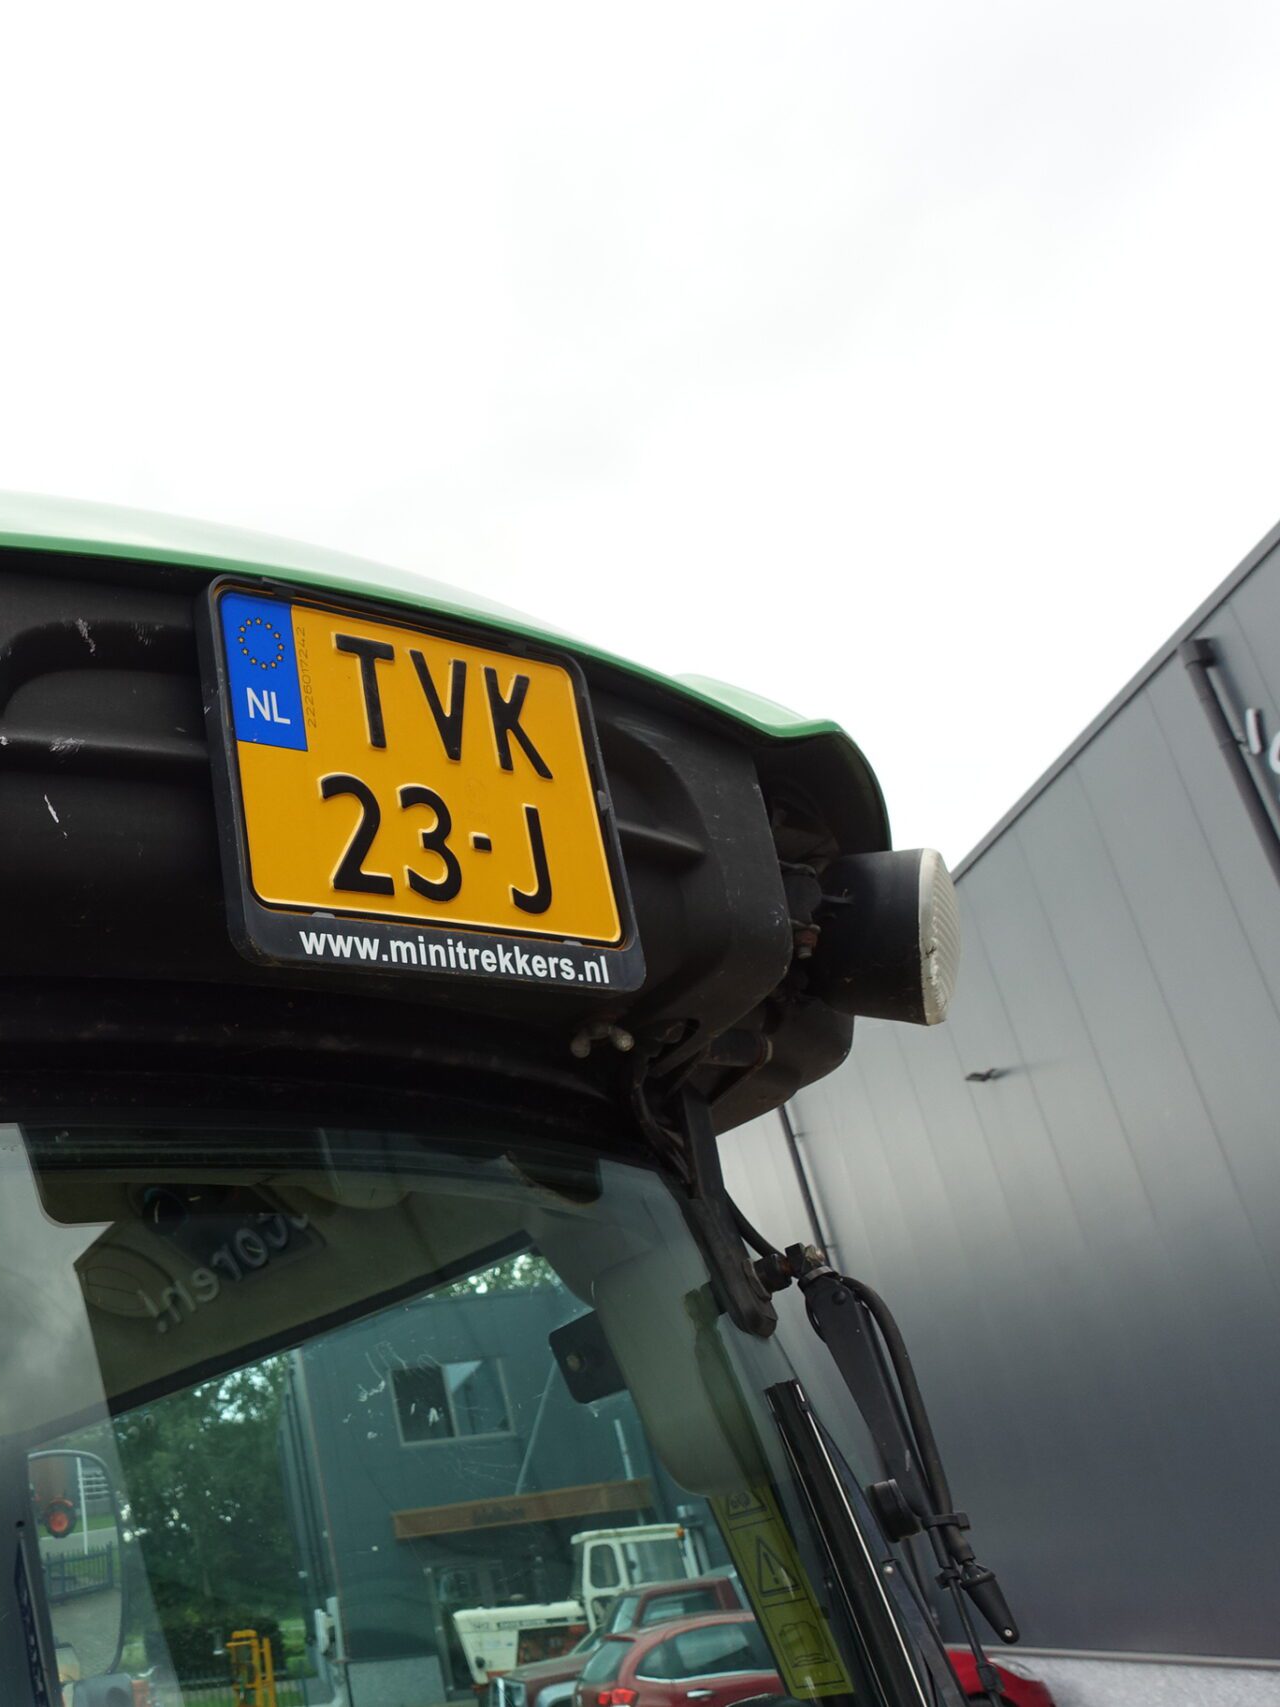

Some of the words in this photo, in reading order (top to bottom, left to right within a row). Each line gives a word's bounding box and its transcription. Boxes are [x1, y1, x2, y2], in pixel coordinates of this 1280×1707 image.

[246, 687, 291, 725] NL
[333, 632, 554, 780] TVK
[320, 774, 553, 915] 23-J
[298, 930, 610, 984] www.minitrekkers.nl
